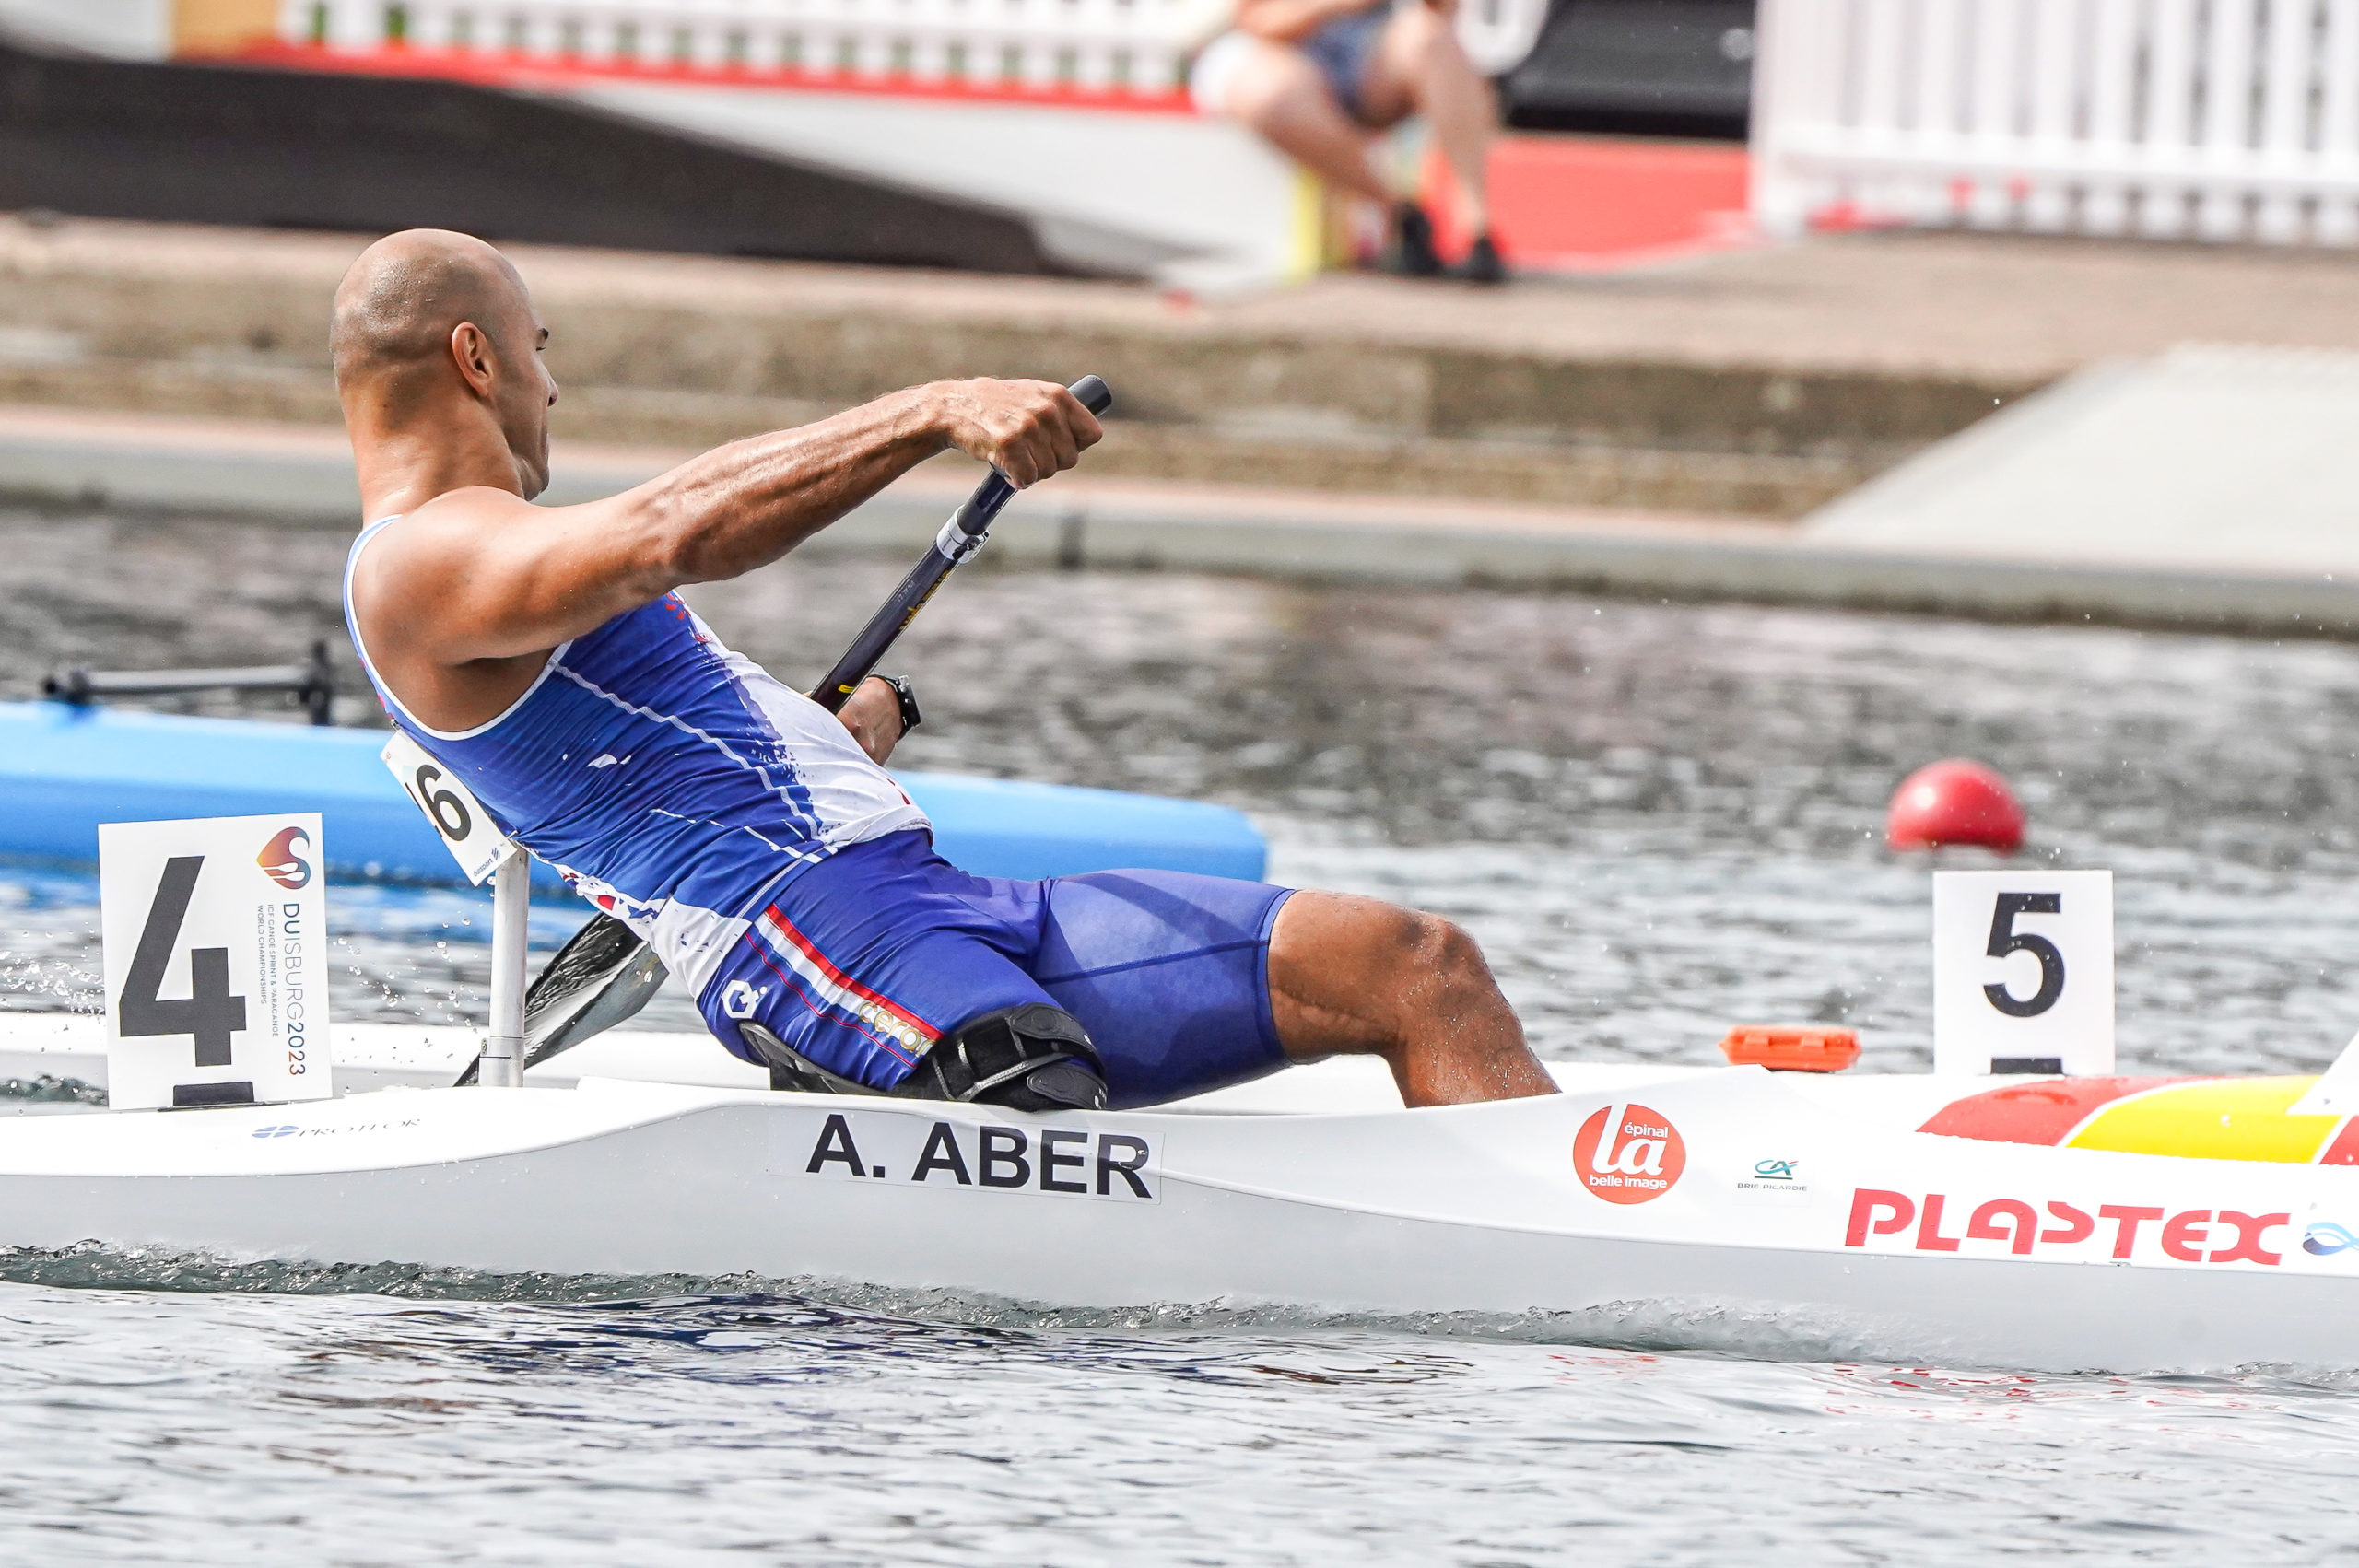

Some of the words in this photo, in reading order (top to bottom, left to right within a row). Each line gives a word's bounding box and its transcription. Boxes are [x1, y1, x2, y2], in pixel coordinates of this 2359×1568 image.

[405, 765, 471, 841] 6
[119, 855, 247, 1067] 4
[258, 936, 267, 1005] CHAMPIONSHIPS
[283, 903, 306, 1076] DUISBURG2023
[1983, 892, 2065, 1018] 5
[271, 988, 279, 1037] PARACANOE
[806, 1114, 886, 1178] A.
[910, 1121, 1153, 1199] ABER
[1591, 1104, 1668, 1176] la
[1624, 1121, 1669, 1138] épinal
[1589, 1174, 1622, 1188] belle
[1625, 1176, 1668, 1189] image
[1762, 1184, 1807, 1192] PICARDIE
[1845, 1188, 2291, 1267] PLASTEX
